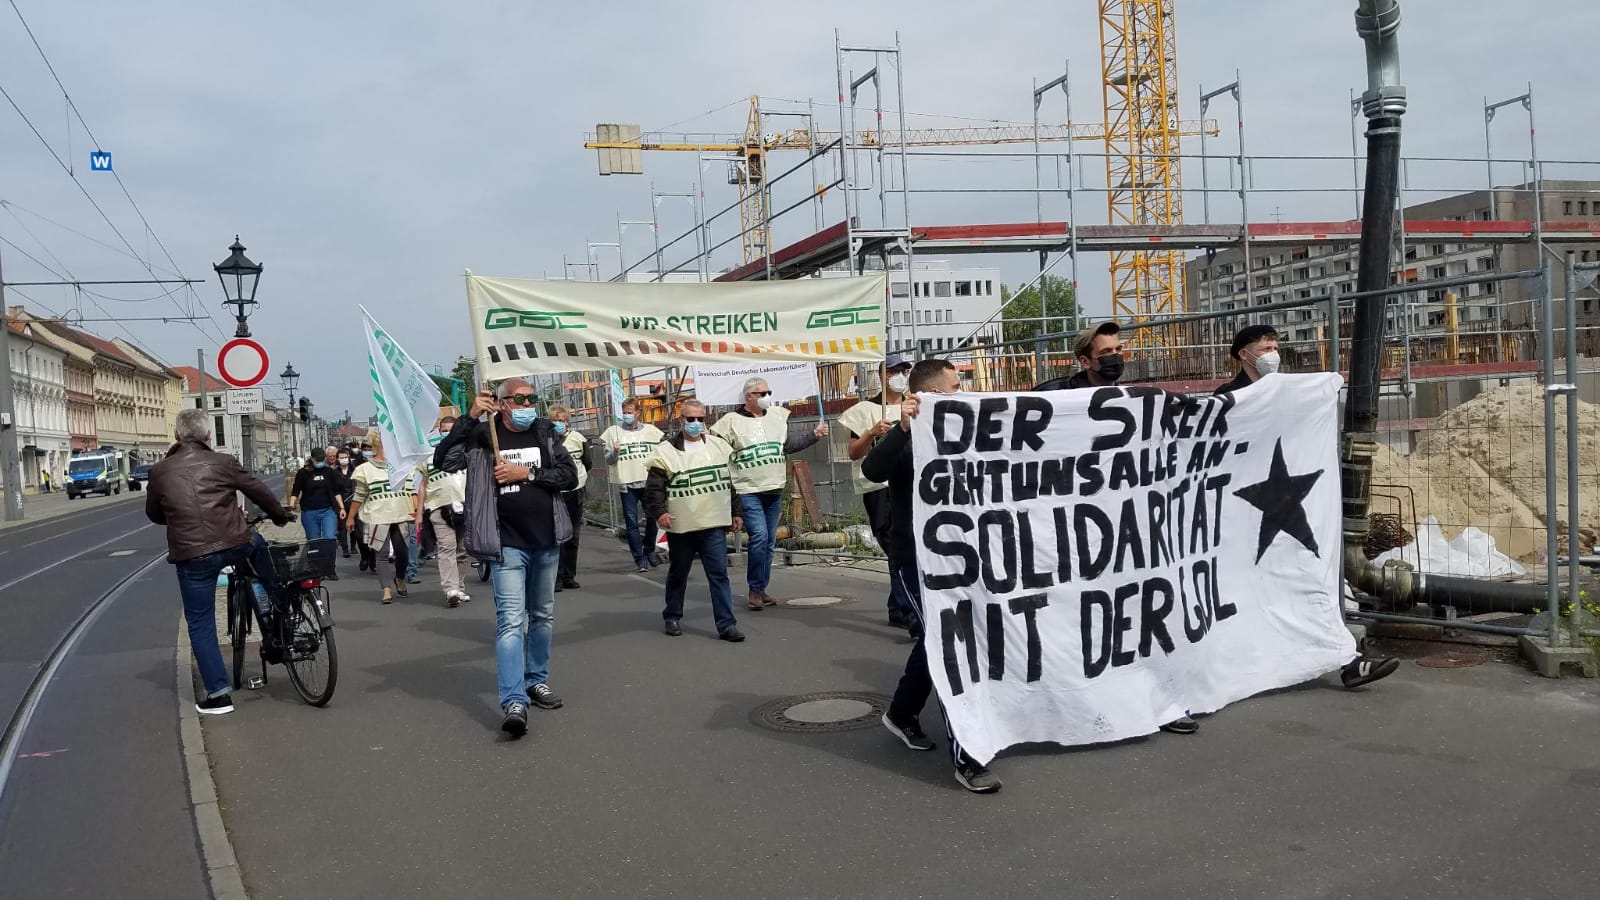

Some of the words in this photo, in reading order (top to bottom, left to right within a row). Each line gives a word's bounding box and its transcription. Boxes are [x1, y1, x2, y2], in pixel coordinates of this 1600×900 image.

[93, 156, 110, 168] W
[666, 311, 778, 335] STREIKEN
[932, 396, 1053, 455] DER
[1088, 386, 1236, 451] STREIK
[1011, 452, 1105, 502] UNS
[1109, 441, 1178, 490] ALLE
[921, 472, 1232, 595] SOLIDARITÄT
[940, 593, 1050, 697] MIT
[1080, 577, 1176, 679] DER
